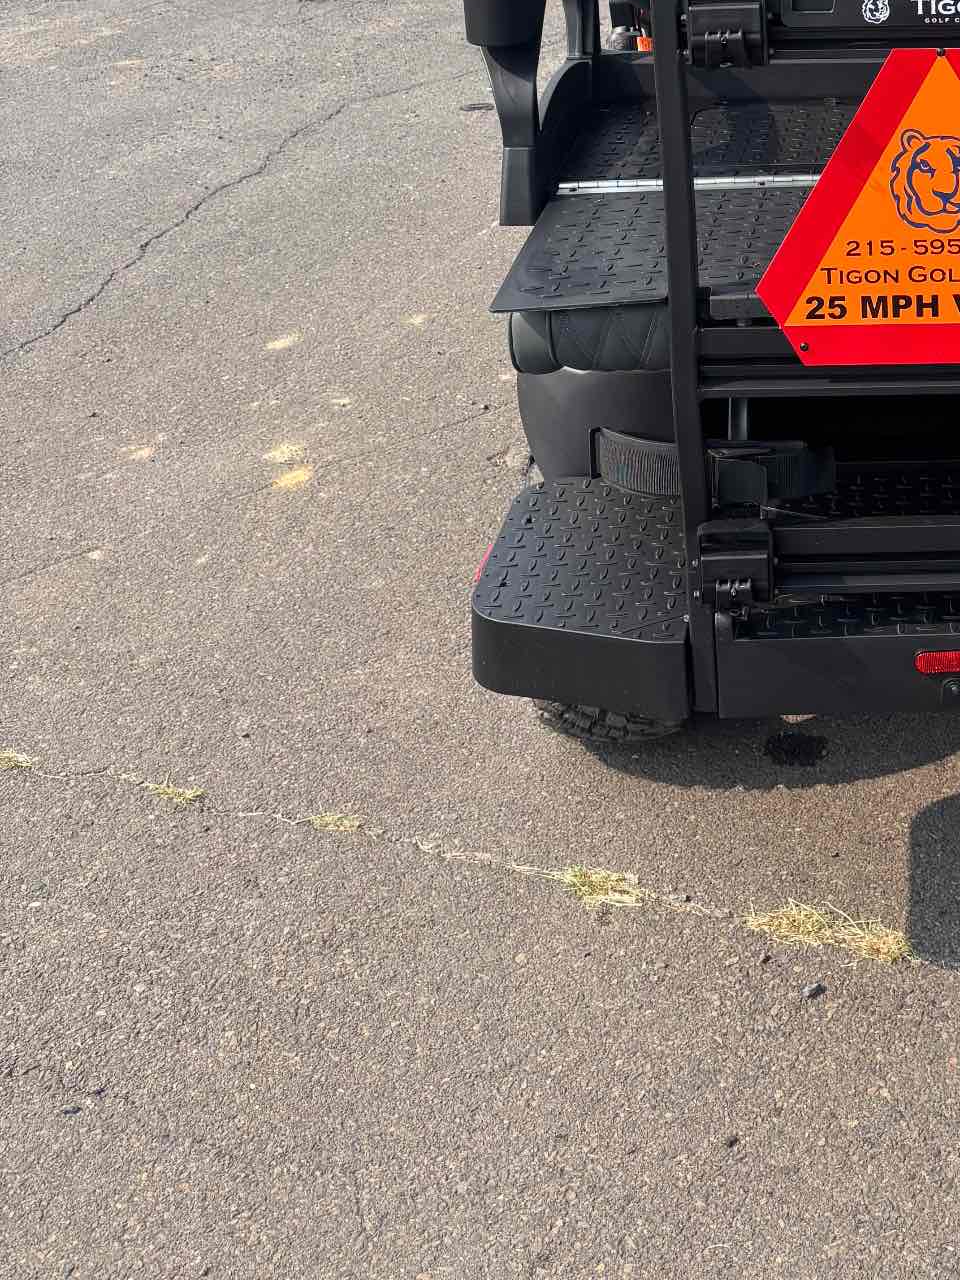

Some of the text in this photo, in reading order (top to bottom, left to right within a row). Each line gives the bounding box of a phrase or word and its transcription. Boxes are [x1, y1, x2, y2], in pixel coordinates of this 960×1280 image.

[820, 266, 900, 285] TIGON
[805, 295, 847, 320] 25
[860, 294, 940, 320] MPH
